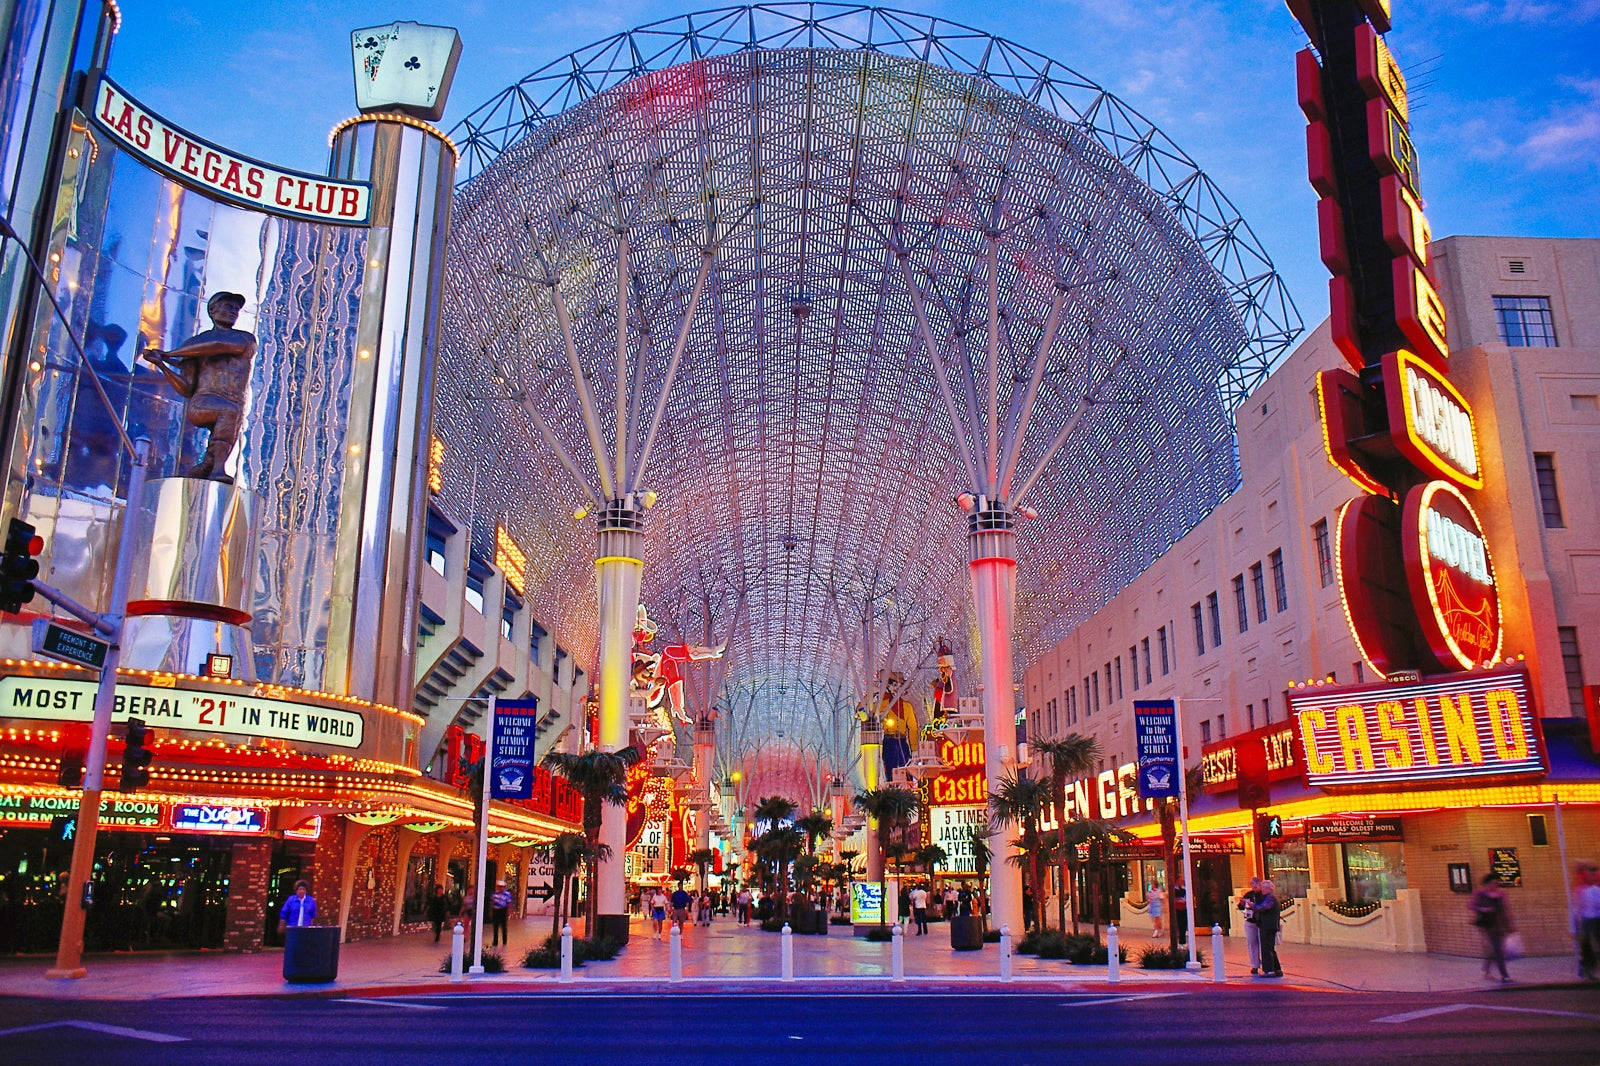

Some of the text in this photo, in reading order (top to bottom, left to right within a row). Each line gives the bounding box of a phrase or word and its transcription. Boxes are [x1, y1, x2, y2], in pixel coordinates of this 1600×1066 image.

[101, 86, 360, 217] LAS VEGAS CLUB
[1426, 506, 1494, 586] HOTEL
[59, 631, 97, 652] FREMONT ST
[56, 643, 94, 661] EXPERIENCE
[12, 688, 354, 738] MOST BERAL "21" IN THE WORLD
[498, 716, 531, 727] WELCOME
[1139, 716, 1172, 726] WELCOME
[512, 727, 525, 736] the
[1154, 726, 1166, 735] the
[1299, 688, 1531, 775] CASINO
[496, 736, 529, 746] FREMONT
[1140, 735, 1172, 745] FREMONT
[499, 746, 525, 756] STREET
[942, 740, 985, 767] Coin
[1143, 744, 1169, 754] STREET
[1140, 755, 1175, 766] Experience
[30, 797, 108, 811] MOMES
[114, 801, 159, 814] ROOM
[183, 808, 200, 817] THE
[945, 808, 988, 825] 5 TIMES
[1332, 819, 1364, 827] WELCOME
[649, 831, 661, 844] OF
[947, 842, 977, 857] EVER
